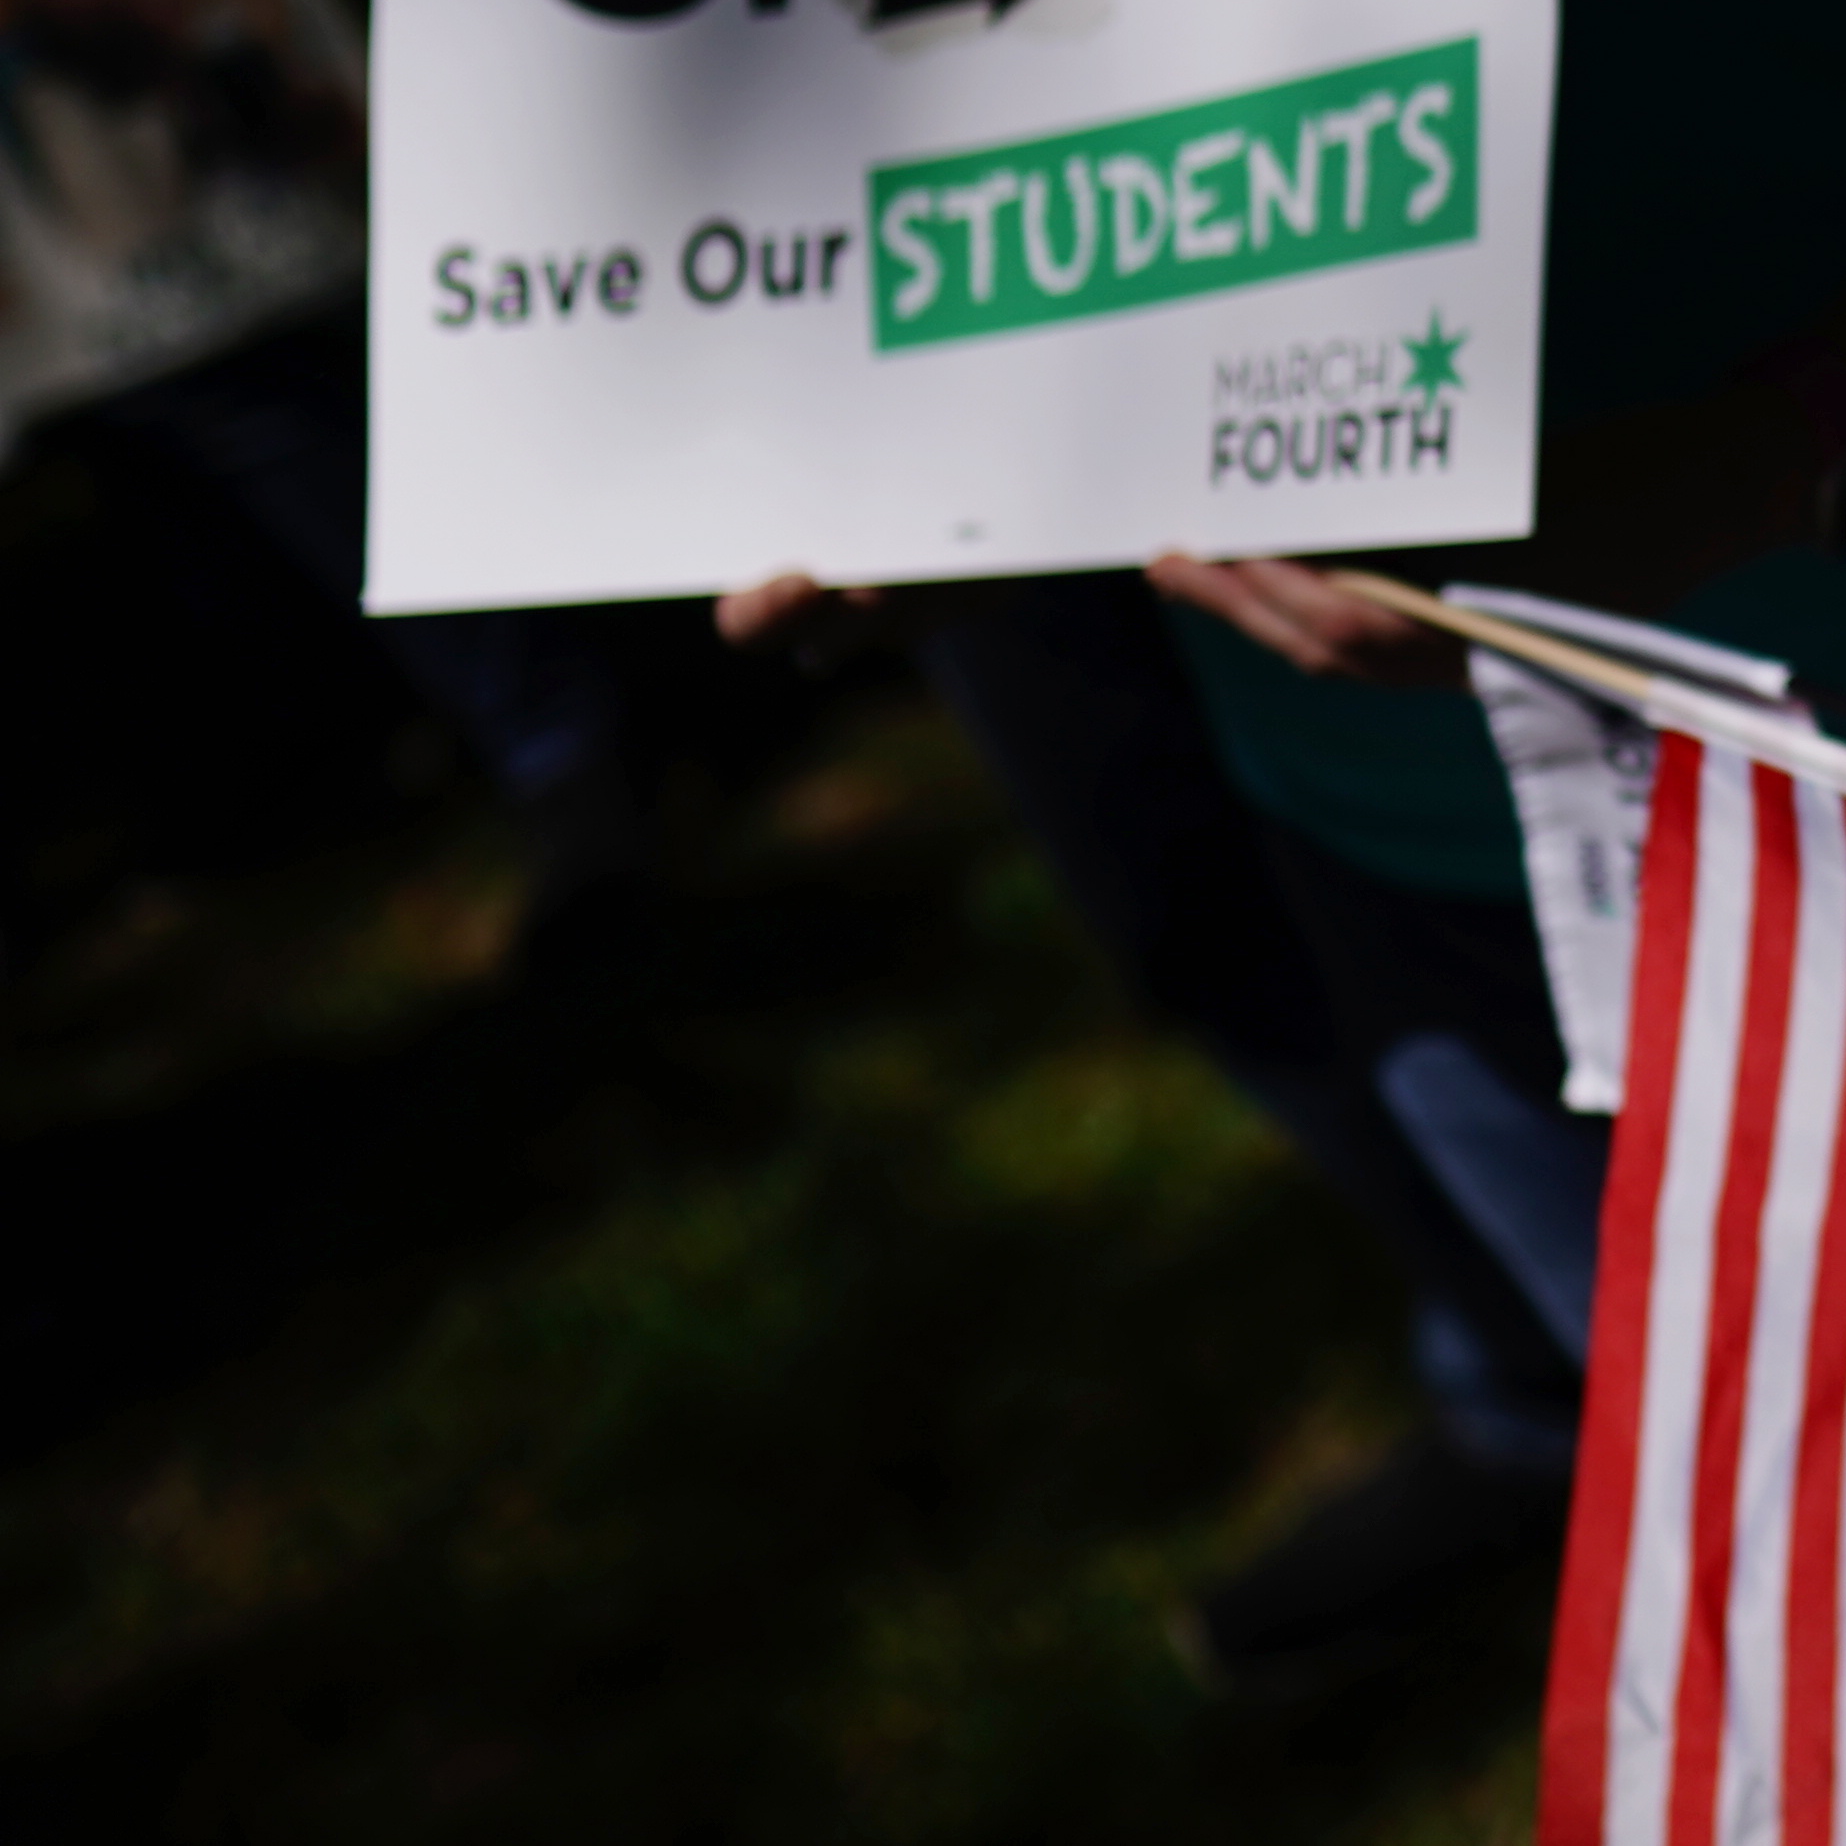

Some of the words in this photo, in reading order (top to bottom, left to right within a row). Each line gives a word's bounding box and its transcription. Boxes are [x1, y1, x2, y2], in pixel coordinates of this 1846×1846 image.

[433, 242, 645, 332] Save
[680, 217, 850, 310] Our
[880, 82, 1455, 324] STUDENTS
[1213, 338, 1392, 406] MARCH
[1211, 404, 1453, 488] FOURTH
